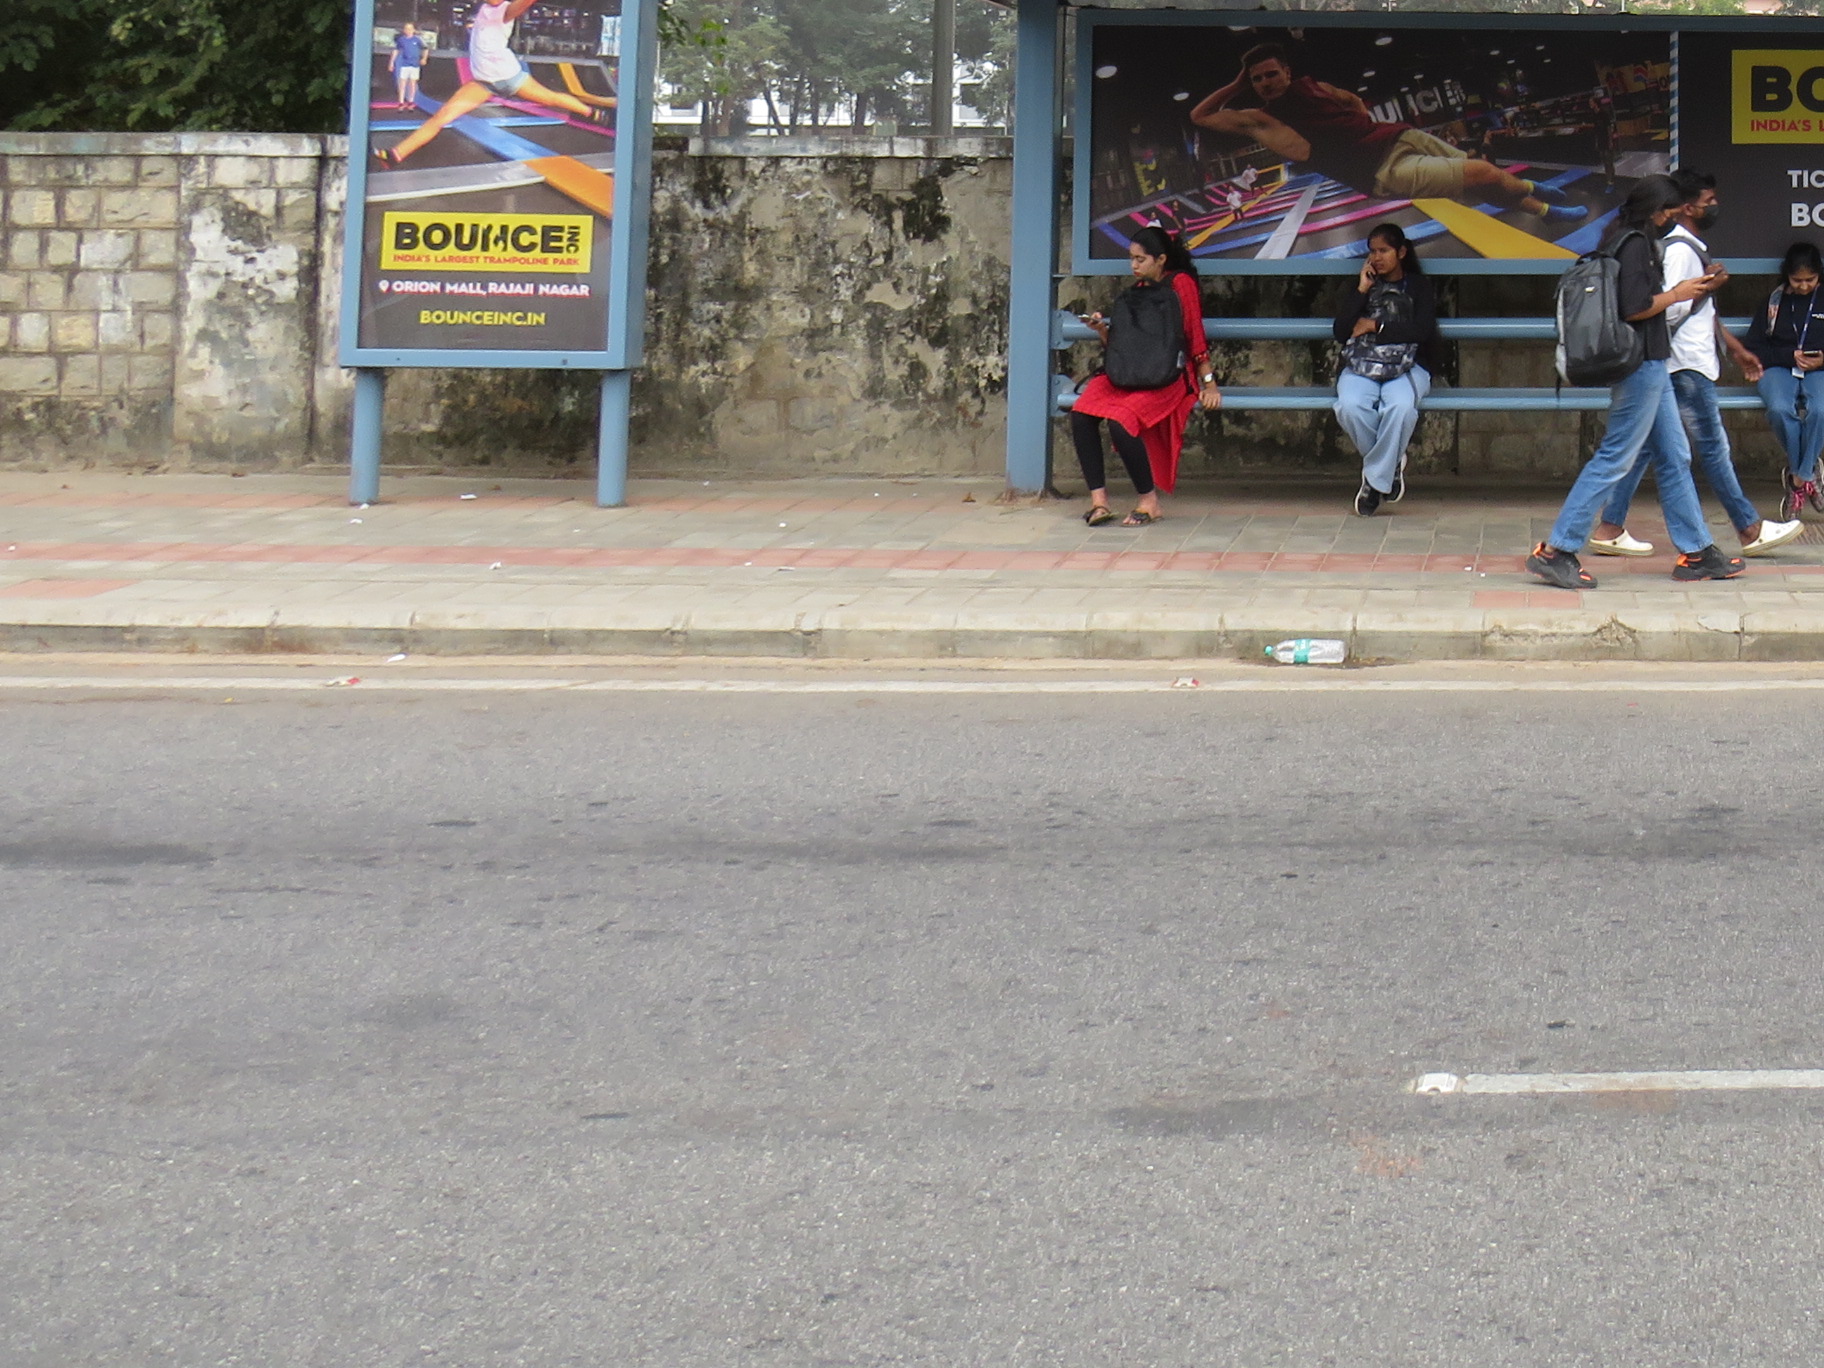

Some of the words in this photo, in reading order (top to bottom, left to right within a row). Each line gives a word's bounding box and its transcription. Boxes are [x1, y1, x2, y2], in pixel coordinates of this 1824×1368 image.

[394, 222, 566, 254] BOUNCE
[434, 256, 480, 264] LARGEST
[483, 256, 549, 266] TRAMPOLINE
[552, 258, 580, 266] PARK
[392, 280, 442, 294] ORION
[488, 282, 534, 296] RAJAJI
[538, 283, 591, 298] NAGAR
[419, 310, 546, 326] BOUNCEINC.IN
